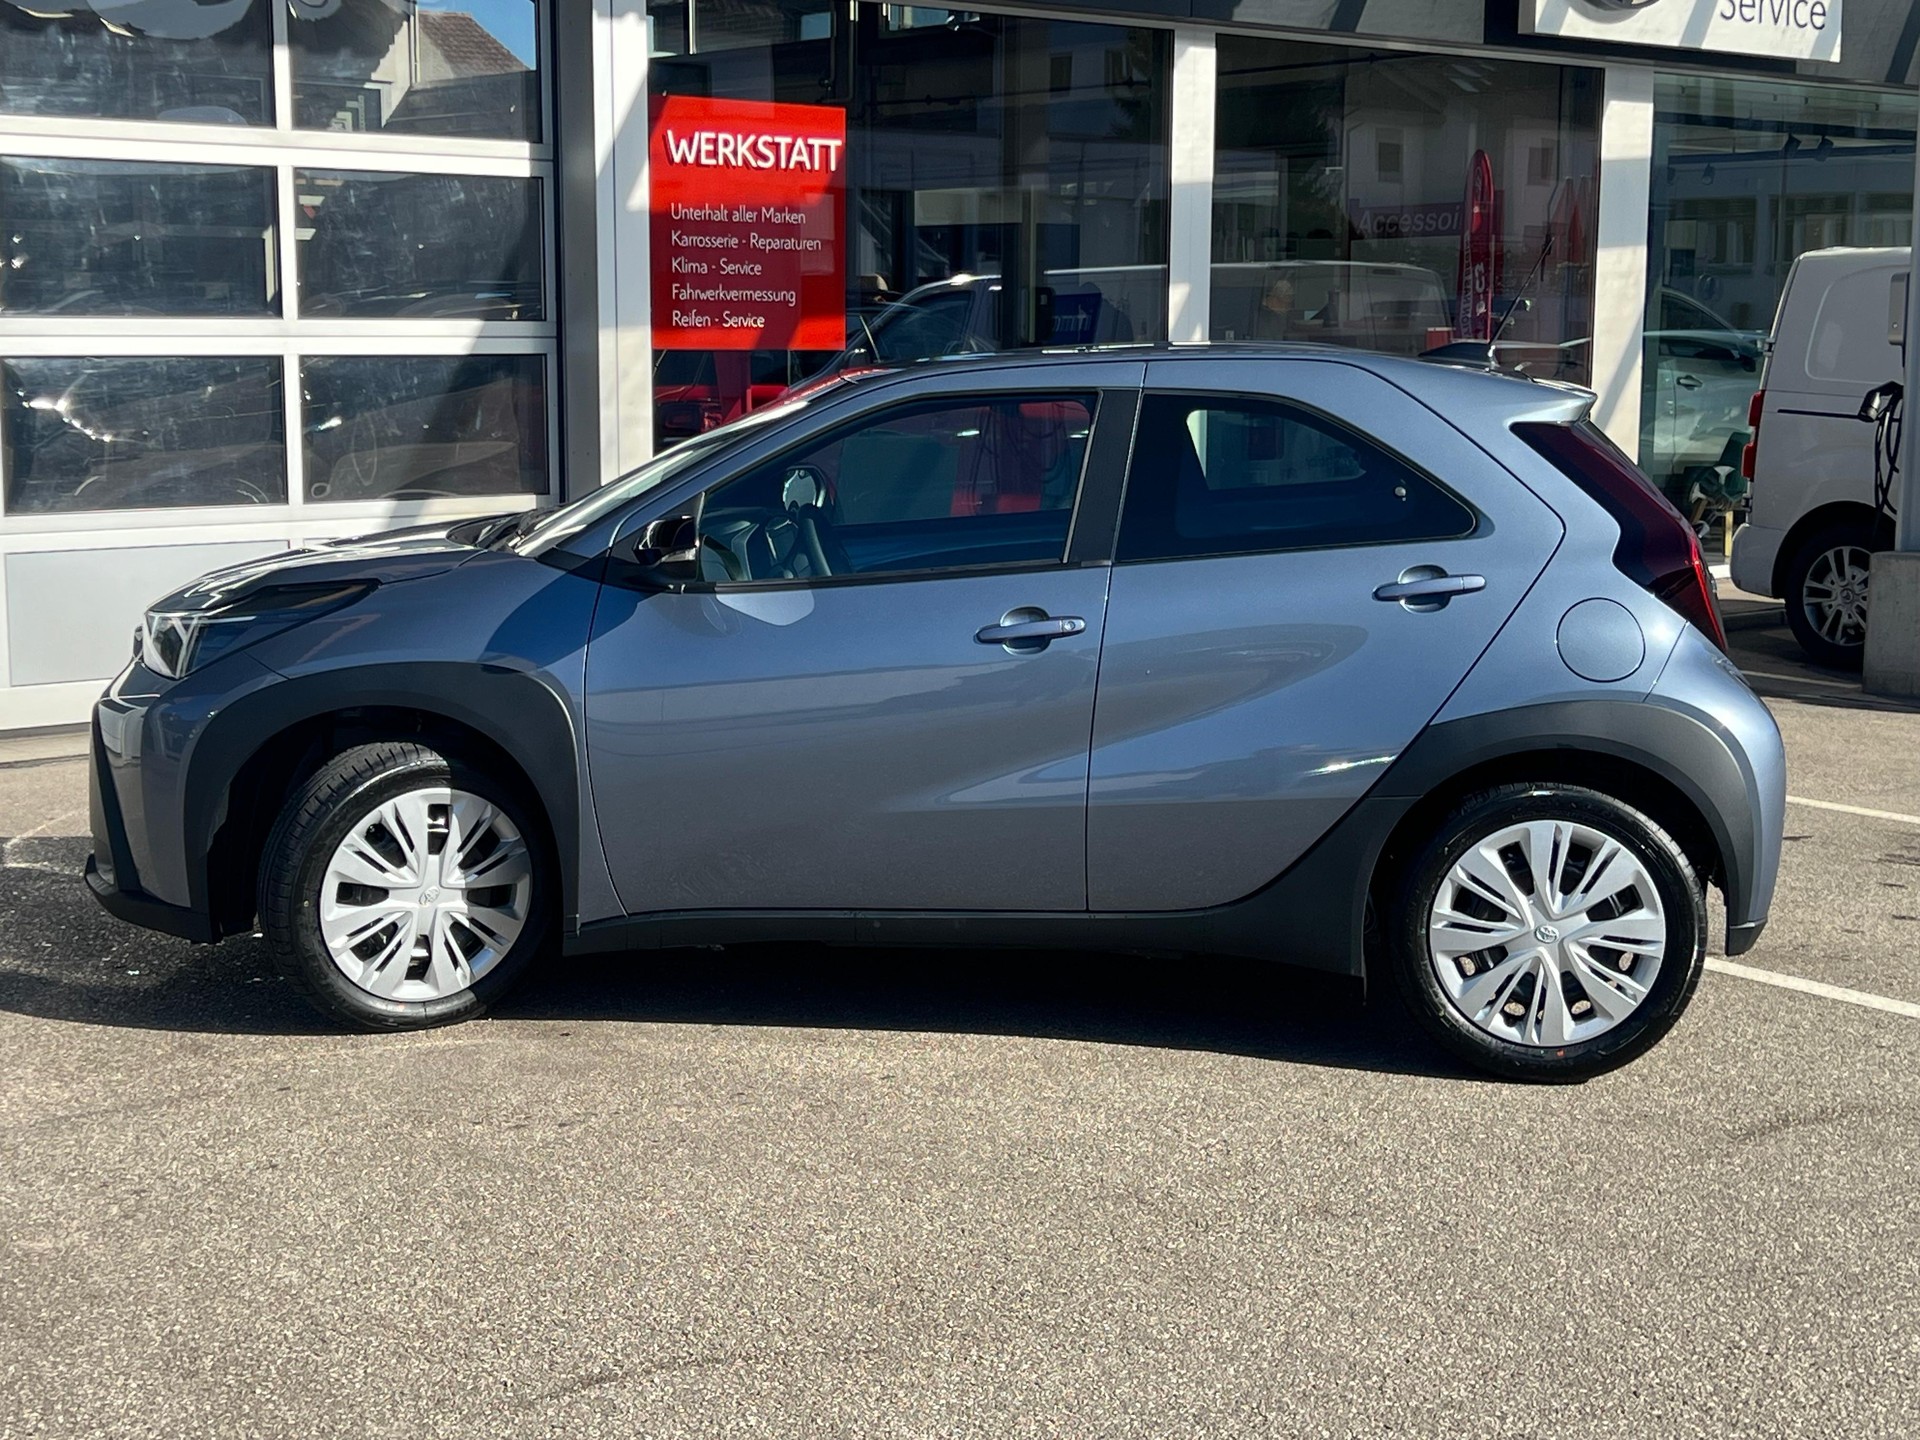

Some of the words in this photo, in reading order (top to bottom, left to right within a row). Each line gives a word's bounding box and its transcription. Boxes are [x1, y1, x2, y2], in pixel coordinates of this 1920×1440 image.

[667, 129, 842, 172] WERKSTATT
[671, 203, 729, 222] Unterhalt
[732, 205, 758, 223] aller
[761, 206, 806, 225] Marken
[671, 231, 739, 249] Karrosserie
[750, 233, 822, 254] Reparaturen
[671, 257, 708, 274] Klima
[719, 258, 762, 276] Service
[672, 284, 796, 307] Fahrwerkvermessung
[672, 310, 711, 328] Reifen
[722, 311, 766, 328] Service
